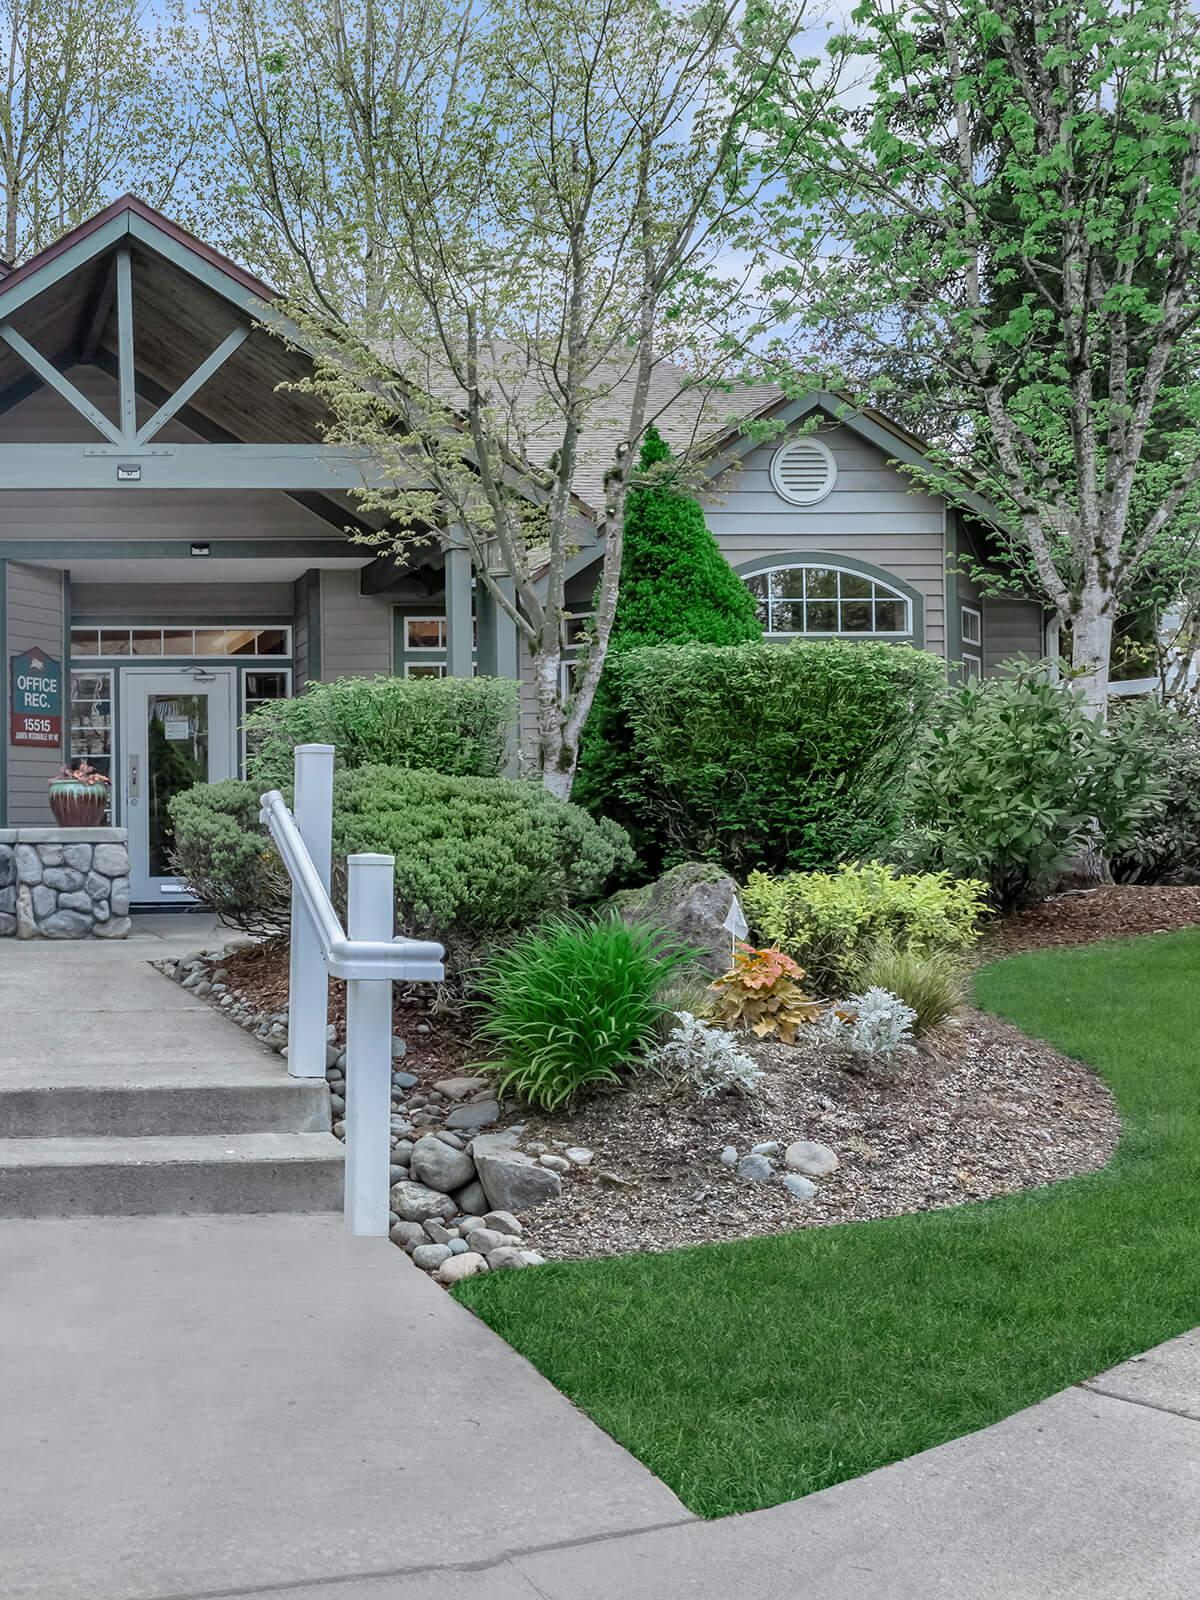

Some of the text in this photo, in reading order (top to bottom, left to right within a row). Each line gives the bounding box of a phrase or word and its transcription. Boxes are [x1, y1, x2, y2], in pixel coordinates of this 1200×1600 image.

[17, 675, 57, 693] OFFICE
[24, 692, 50, 708] REC.
[23, 718, 51, 732] 15515
